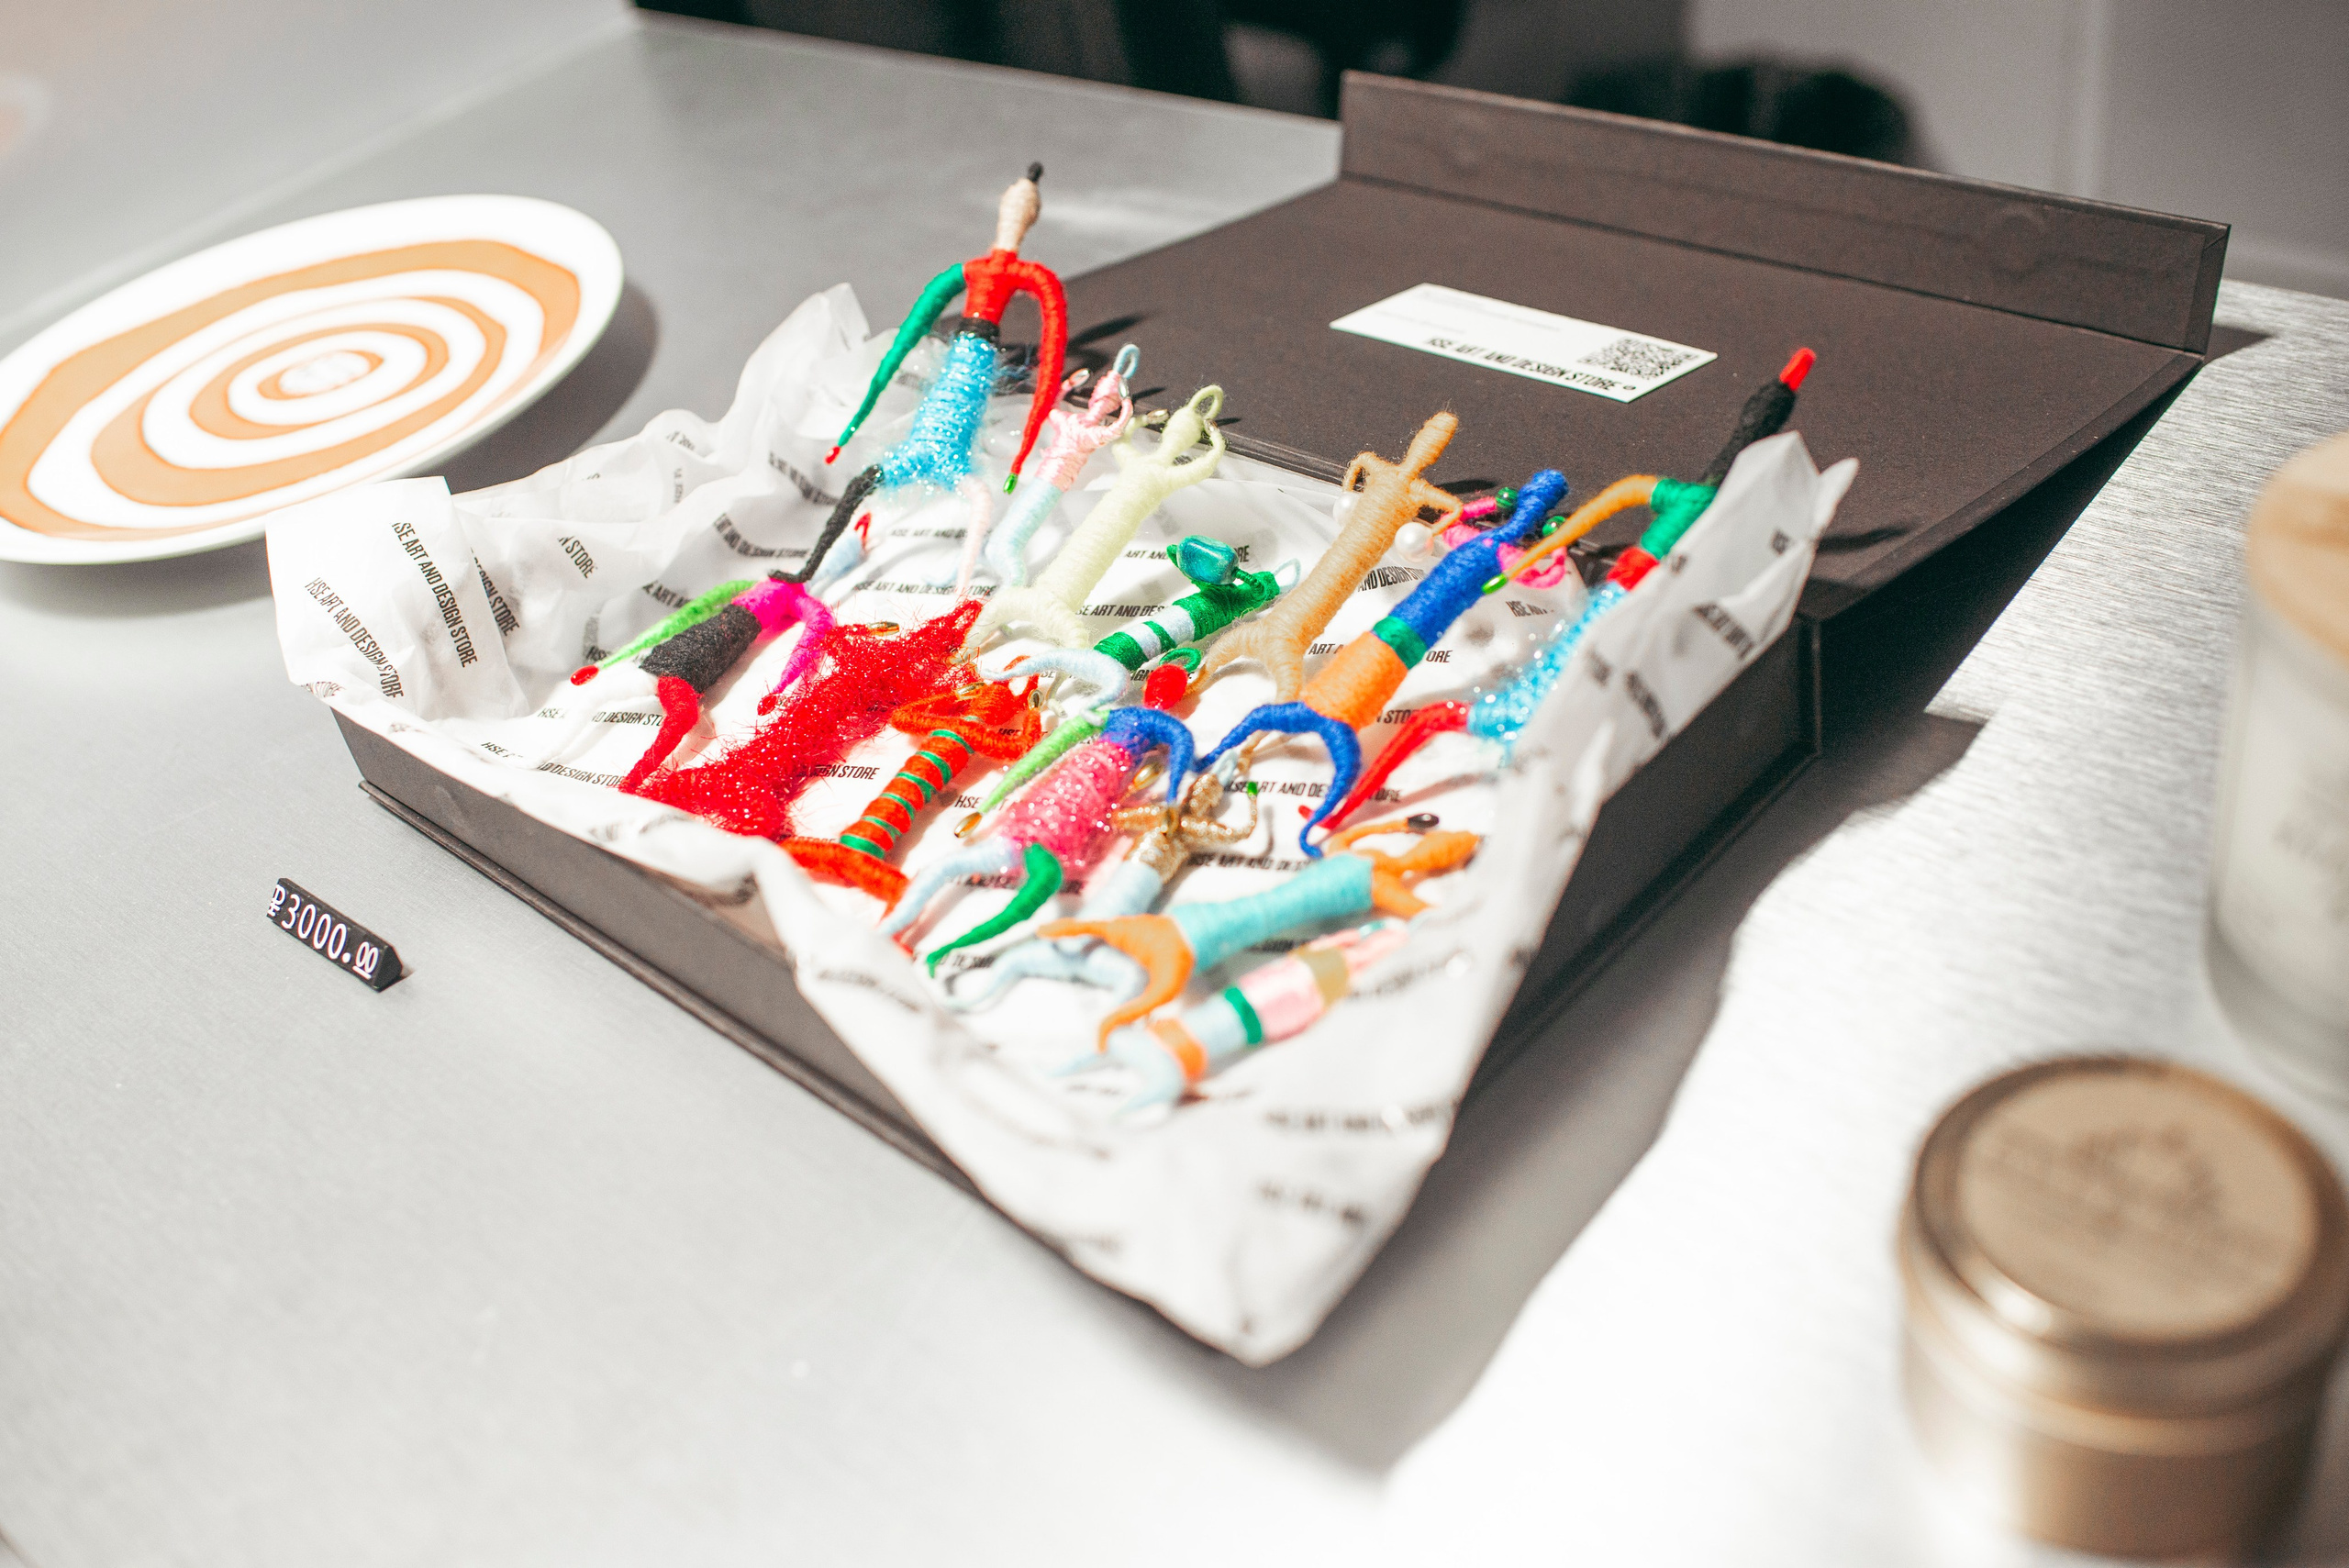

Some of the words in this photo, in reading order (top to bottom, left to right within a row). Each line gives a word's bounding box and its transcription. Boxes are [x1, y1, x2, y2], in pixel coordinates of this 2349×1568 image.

[1565, 372, 1621, 390] STORE
[565, 539, 597, 579] STORE
[1377, 566, 1413, 587] DESIGN
[305, 577, 330, 599] HSE
[317, 592, 344, 613] ART
[403, 539, 429, 561] ART
[418, 561, 443, 585] AND
[431, 583, 462, 628] DESIGN
[450, 626, 478, 668] STORE
[1091, 605, 1117, 617] ART
[1114, 605, 1140, 617] AND
[333, 607, 361, 633] AND
[489, 595, 520, 637] STORE
[350, 627, 389, 665] DESIGN
[1308, 643, 1335, 655] ART
[1426, 650, 1453, 663] ORE
[376, 664, 404, 698] STORE
[604, 711, 646, 725] DESIGN
[481, 741, 508, 755] HSE
[550, 764, 596, 783] DESIGN
[592, 773, 625, 787] STOR
[837, 765, 881, 780] STORE
[1278, 783, 1307, 796] AND
[954, 795, 983, 809] HSE
